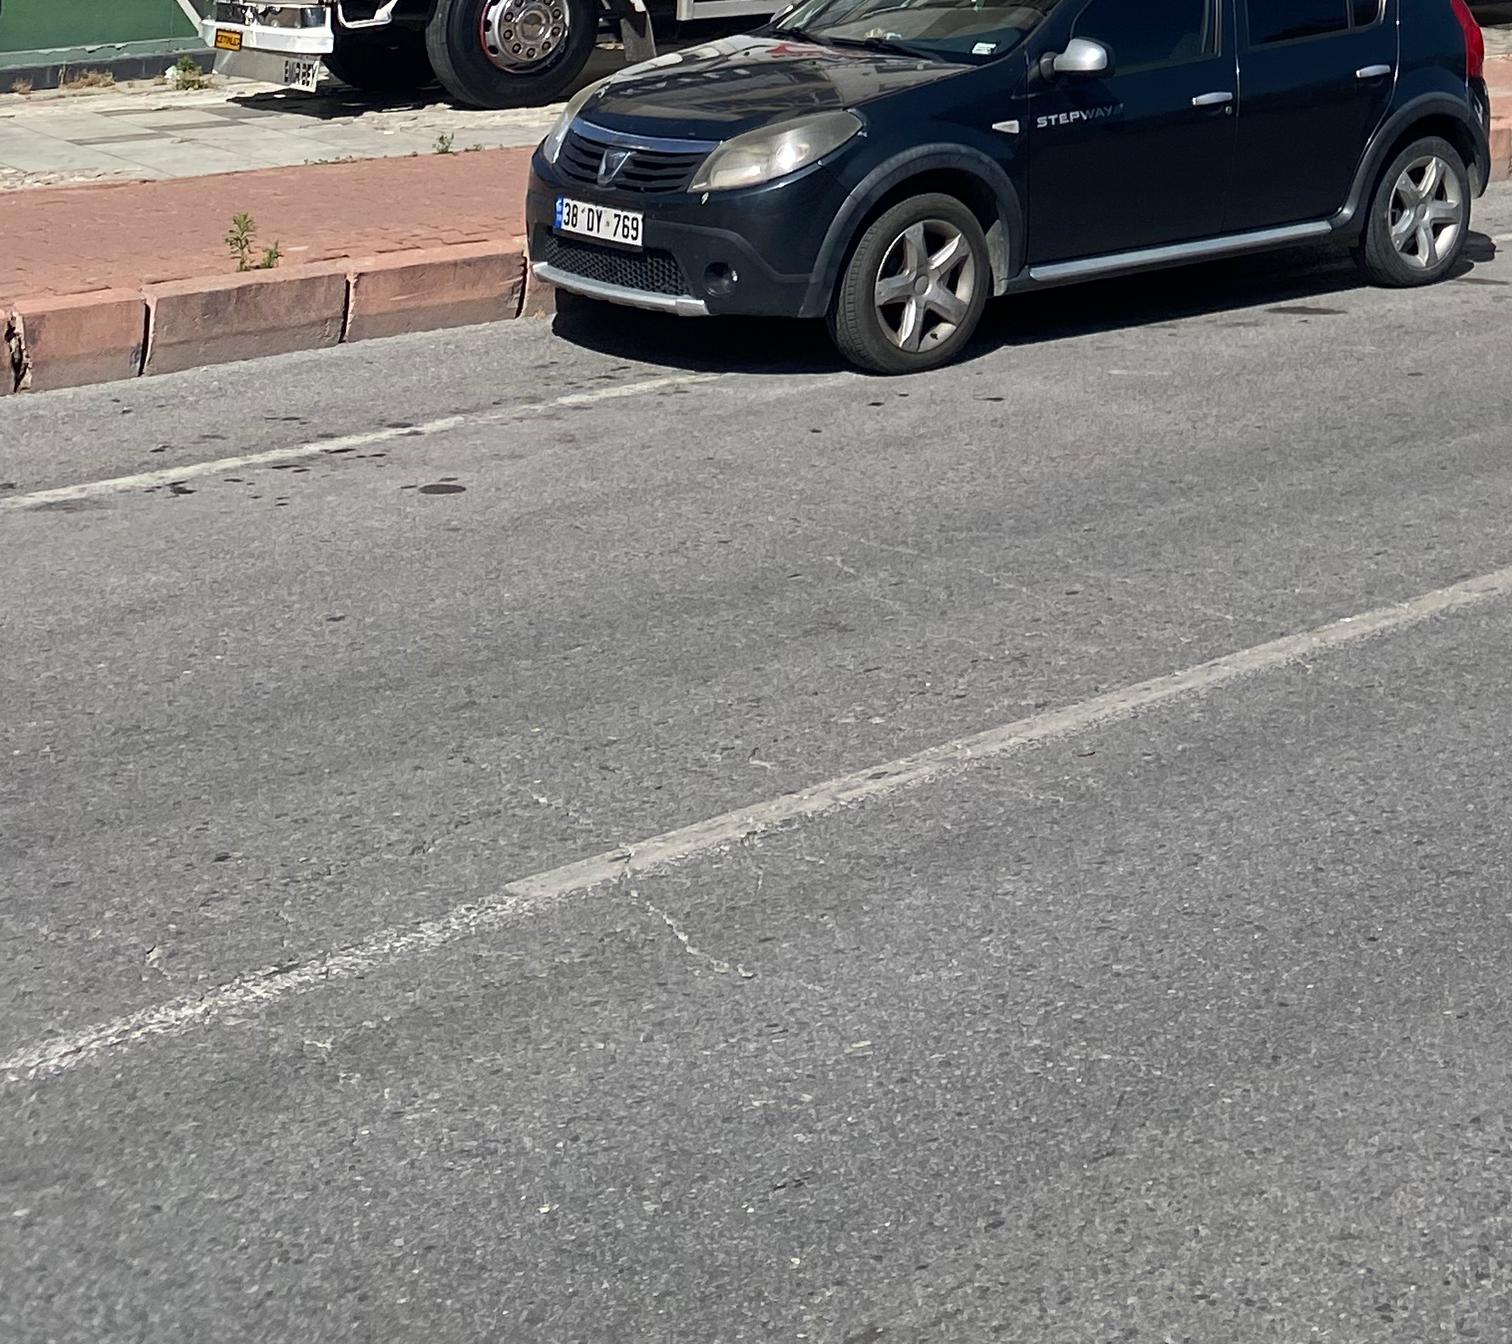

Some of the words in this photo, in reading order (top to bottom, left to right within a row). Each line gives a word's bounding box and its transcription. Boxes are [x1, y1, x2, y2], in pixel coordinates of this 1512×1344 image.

[1036, 105, 1114, 129] STEPWAY
[563, 202, 579, 228] 38
[586, 207, 603, 234] DY
[613, 213, 639, 241] 769
